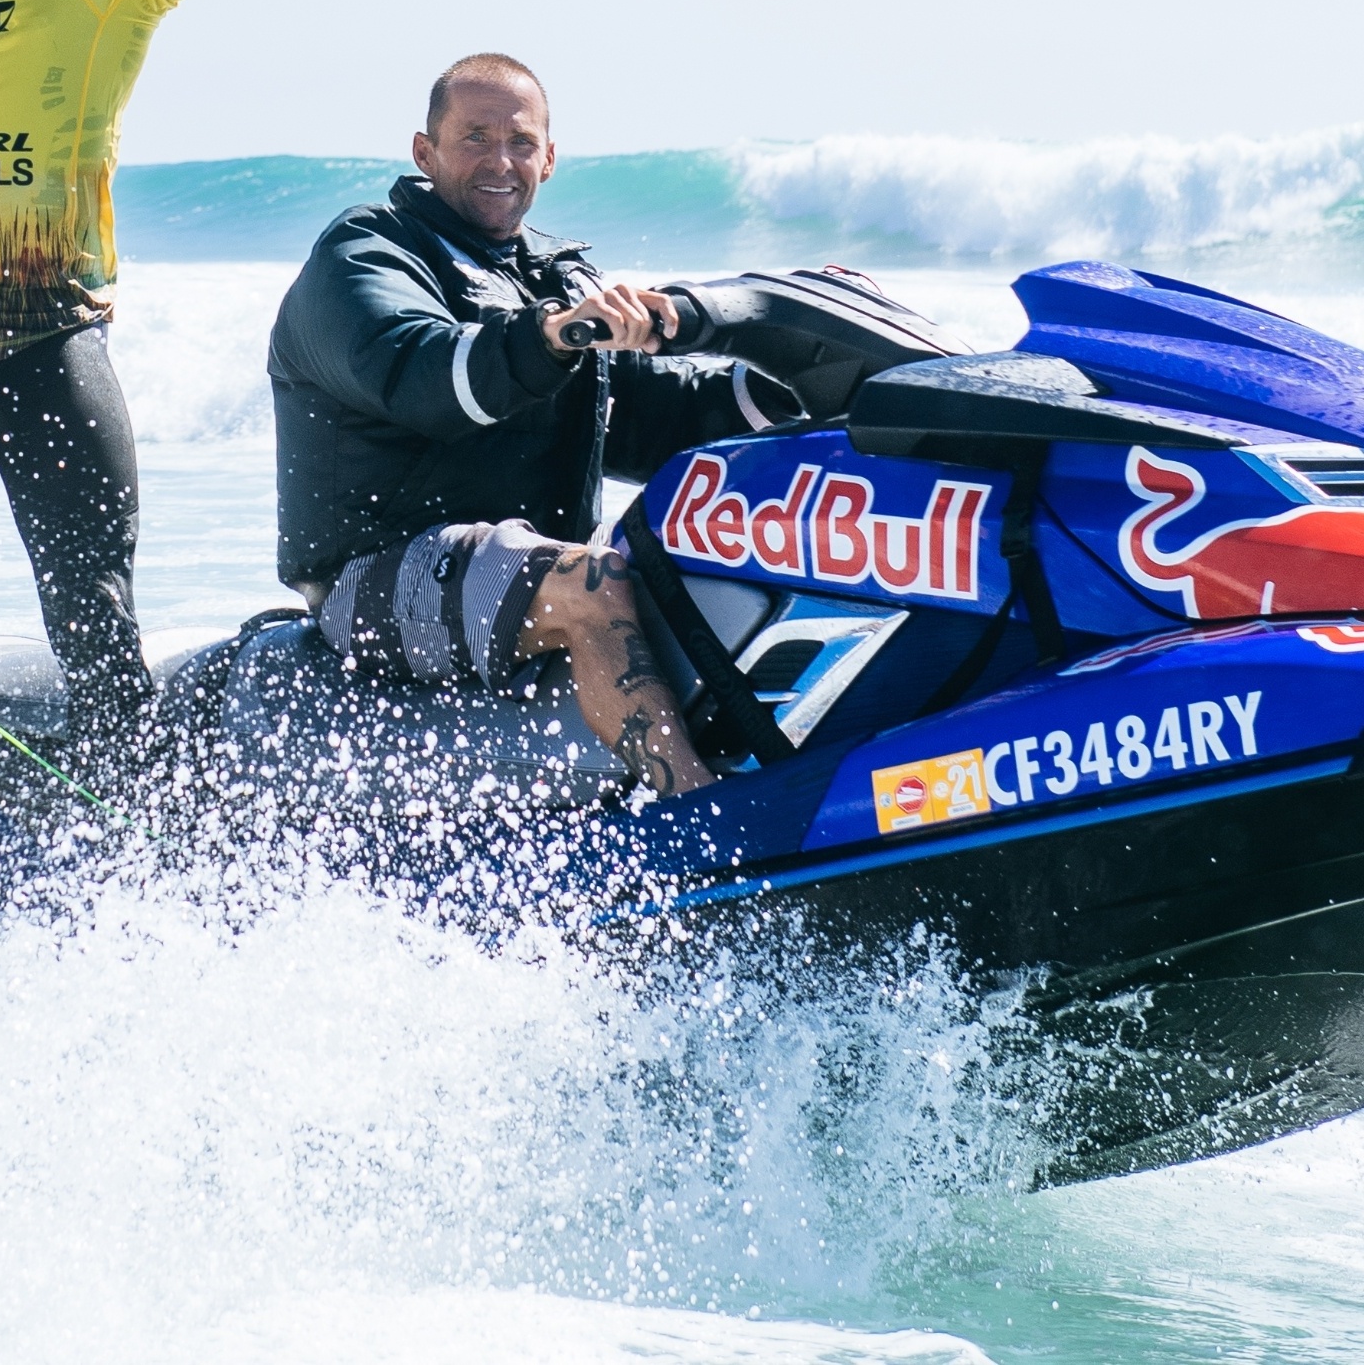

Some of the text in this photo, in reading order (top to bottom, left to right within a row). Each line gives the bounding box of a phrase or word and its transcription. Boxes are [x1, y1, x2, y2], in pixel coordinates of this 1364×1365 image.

[665, 457, 816, 571] Red
[814, 478, 983, 594] Bull
[947, 761, 983, 805] 21
[983, 690, 1263, 806] CF3484RY
